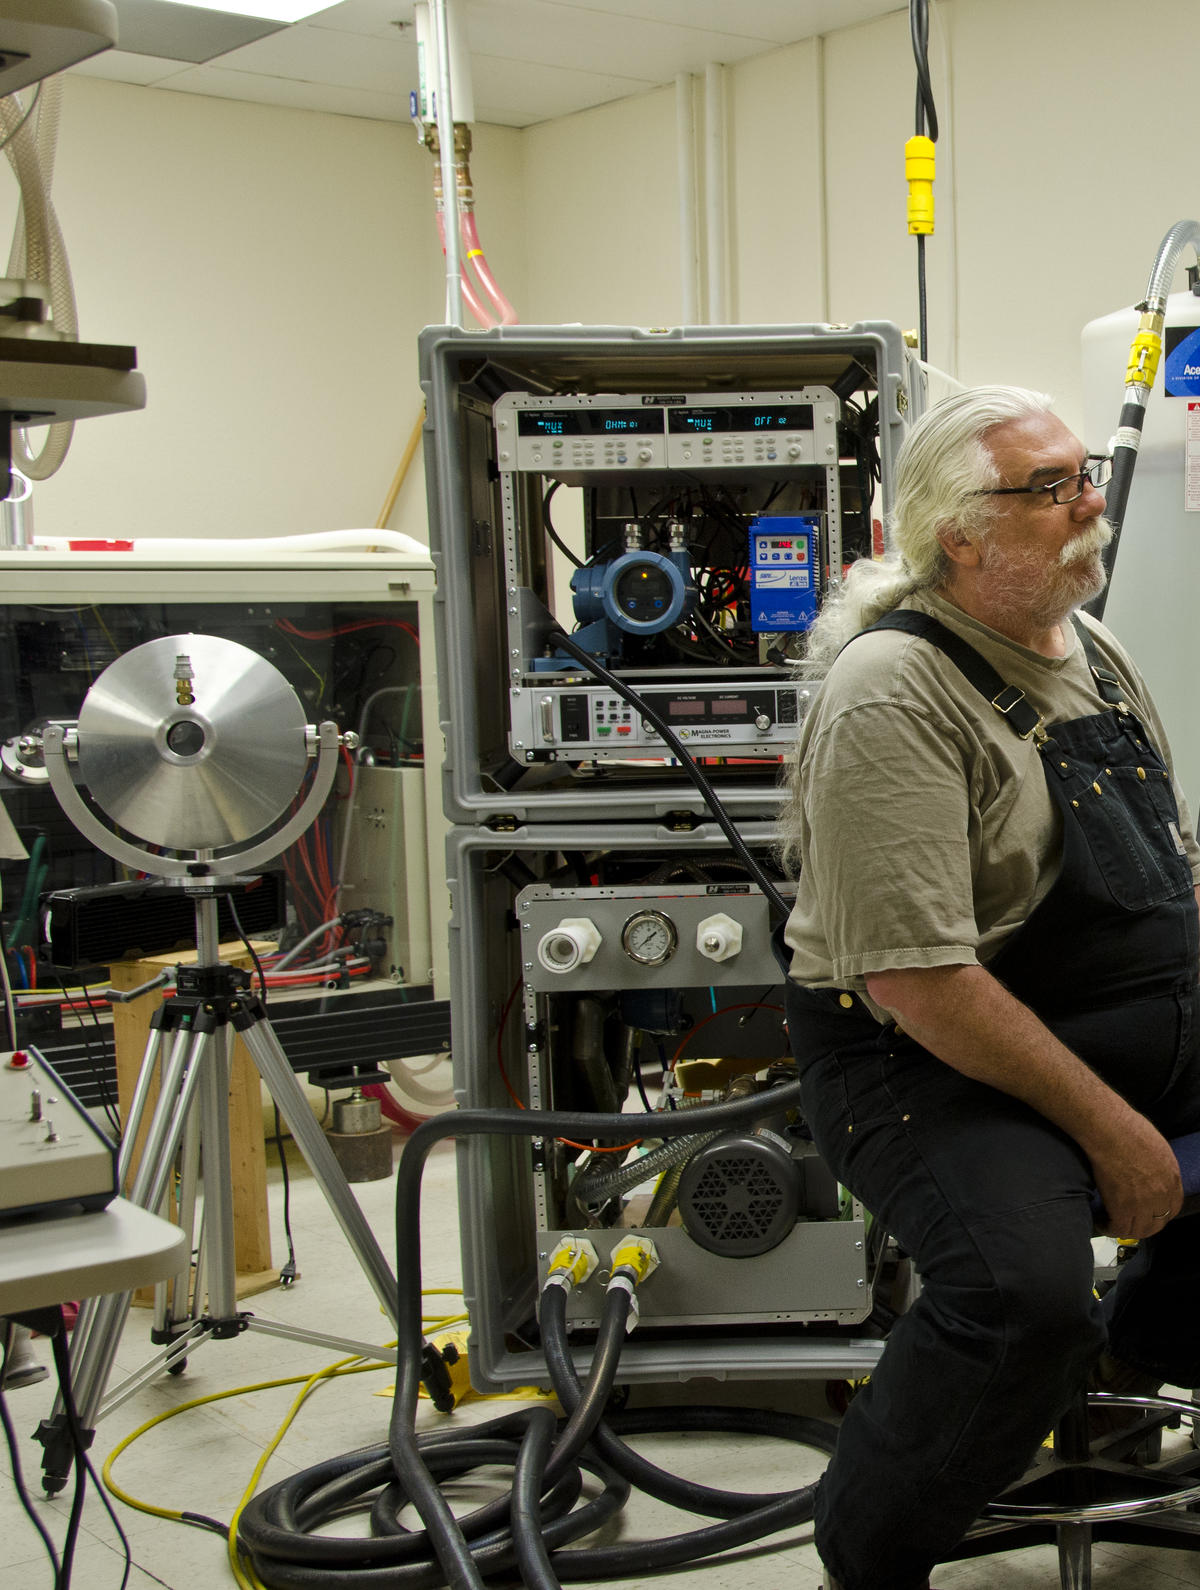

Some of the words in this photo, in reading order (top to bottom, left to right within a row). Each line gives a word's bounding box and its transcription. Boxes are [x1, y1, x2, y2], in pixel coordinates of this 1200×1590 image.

[1184, 364, 1200, 375] Ace
[754, 416, 772, 426] OFF
[691, 729, 730, 737] MAGNA-POWER
